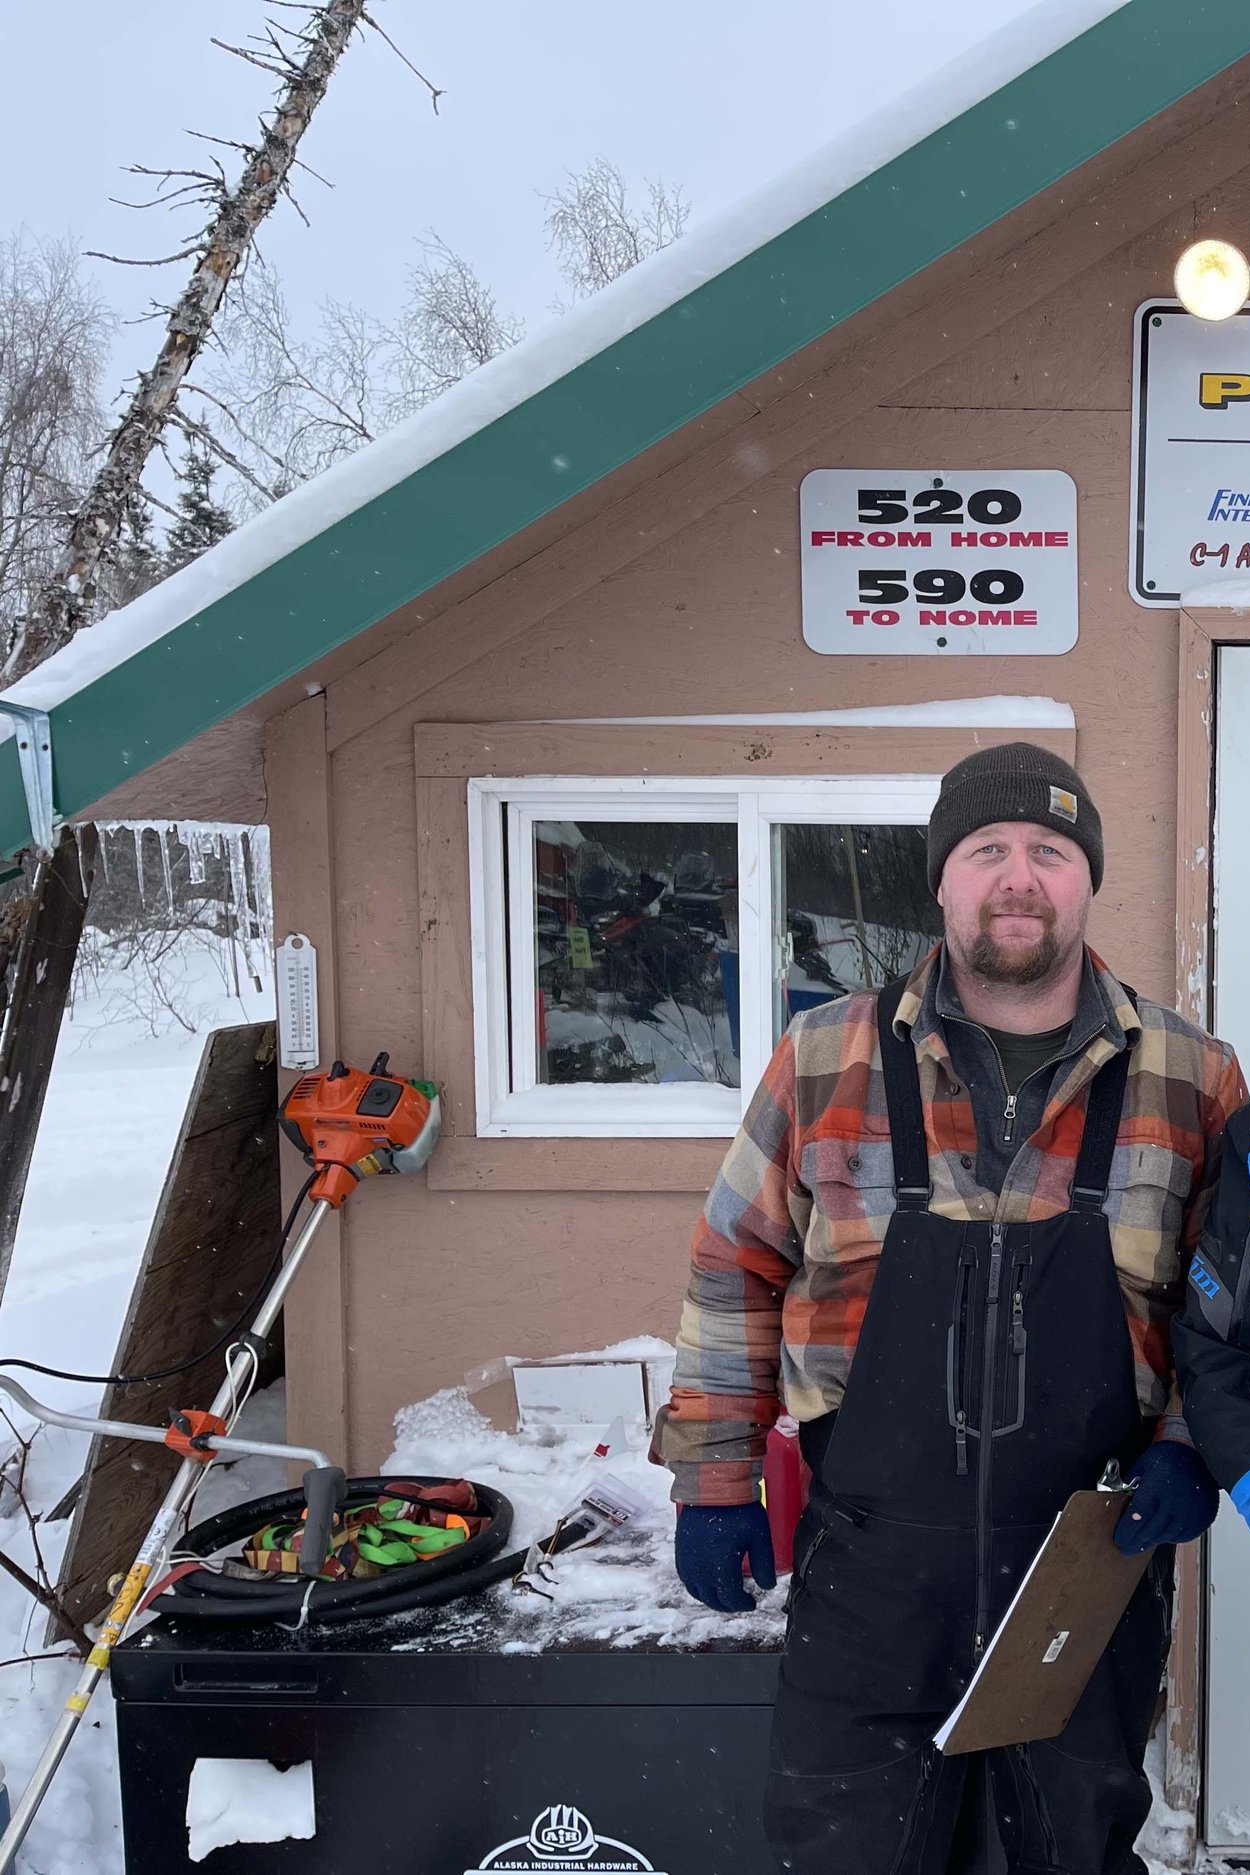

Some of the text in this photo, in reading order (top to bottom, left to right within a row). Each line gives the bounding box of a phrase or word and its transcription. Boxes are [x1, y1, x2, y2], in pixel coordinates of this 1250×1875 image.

[857, 488, 1022, 524] 520
[811, 531, 1069, 547] FROM HOME
[858, 569, 1024, 604] 590
[846, 610, 1037, 626] TO NOME
[493, 1861, 639, 1871] ALASKA INDUSTRIAL HARDWARE
